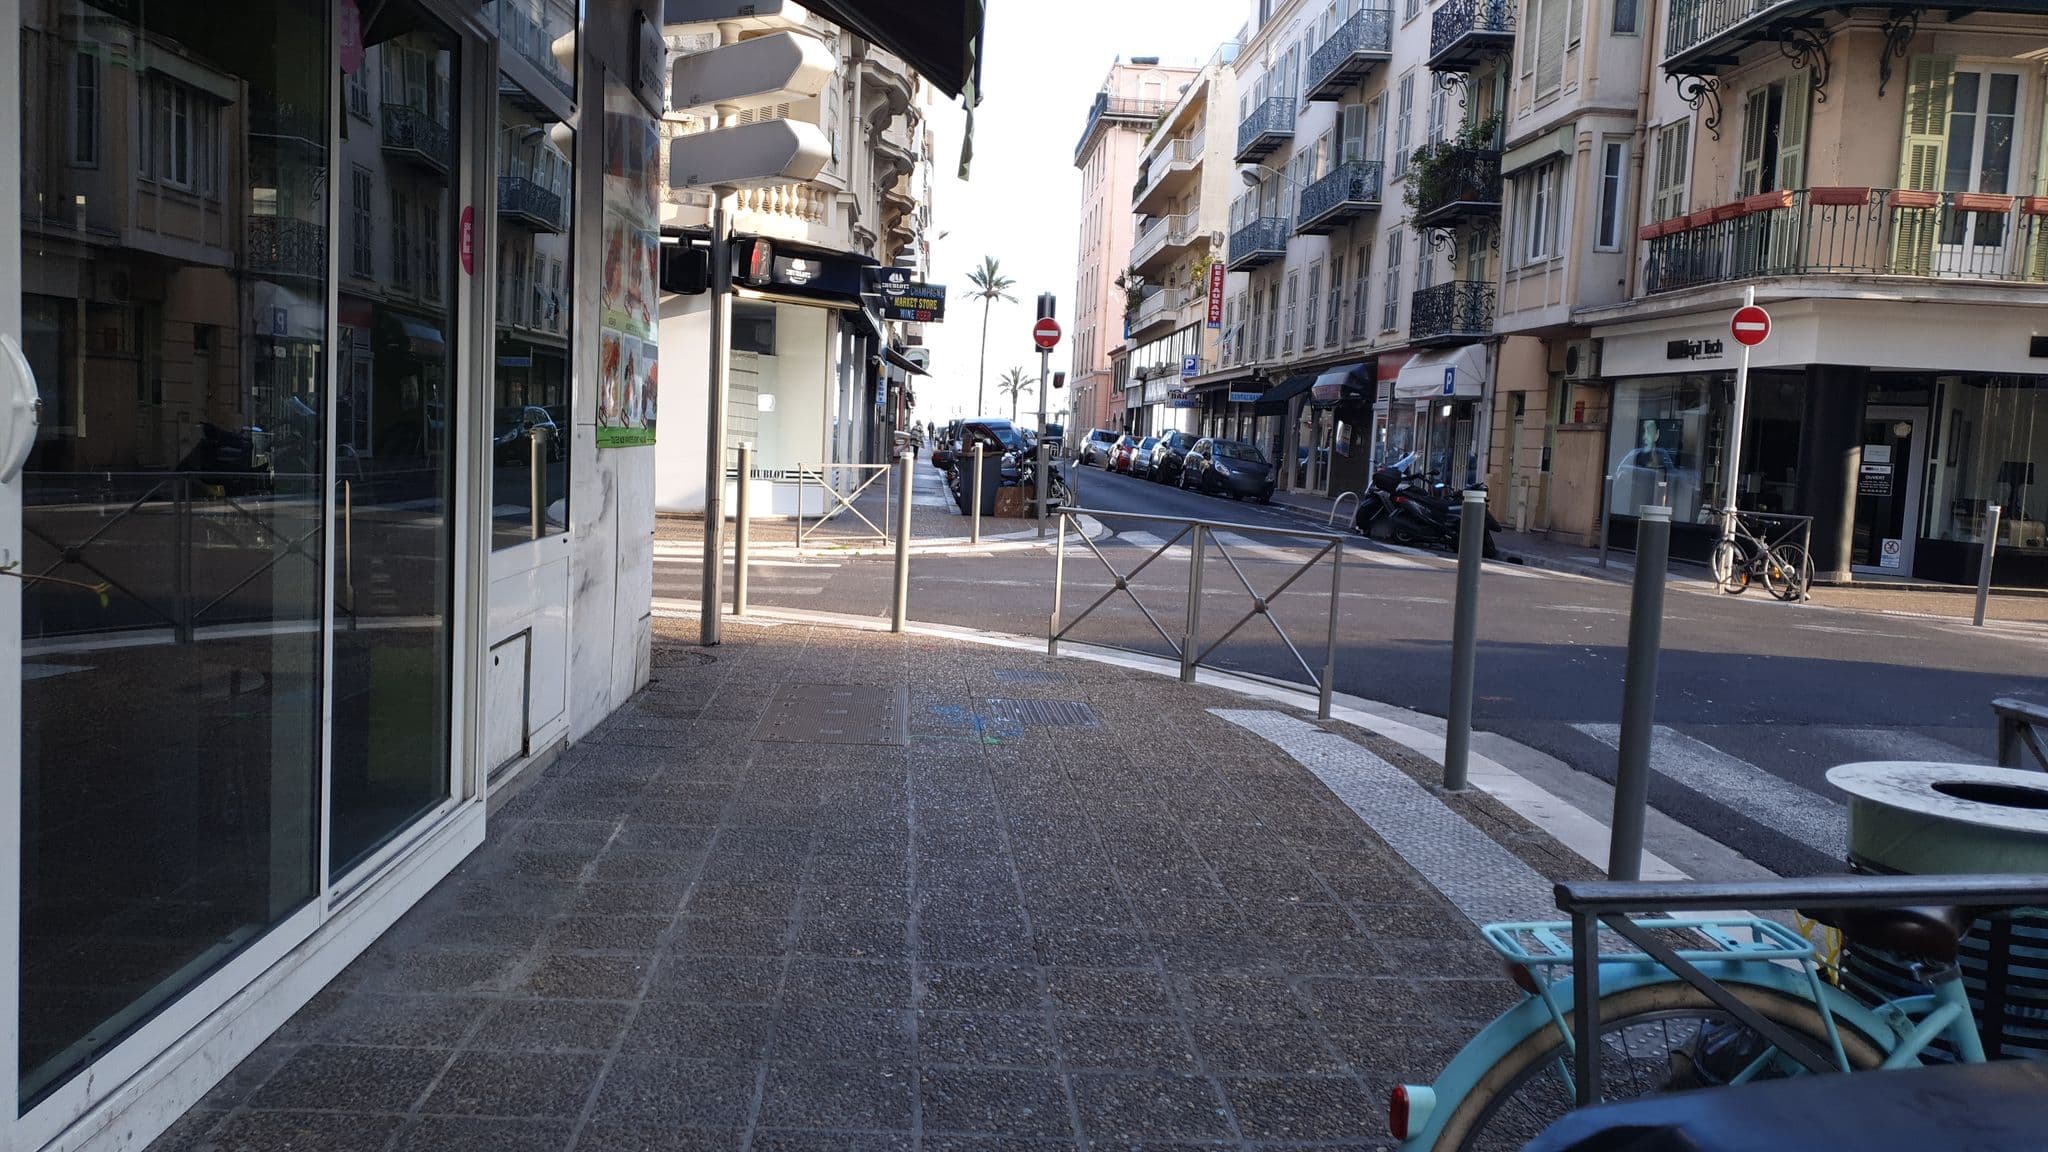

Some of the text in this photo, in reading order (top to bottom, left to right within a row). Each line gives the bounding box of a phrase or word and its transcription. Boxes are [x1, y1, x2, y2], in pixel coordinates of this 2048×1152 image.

[910, 287, 945, 298] CHAMPAGNE
[1211, 264, 1222, 321] RESTAURANT
[894, 297, 938, 310] MARKET STORE
[900, 309, 915, 319] WINE
[1703, 339, 1723, 354] Tech
[1185, 359, 1195, 370] P
[1446, 372, 1453, 390] P
[750, 469, 786, 479] HUBLOT
